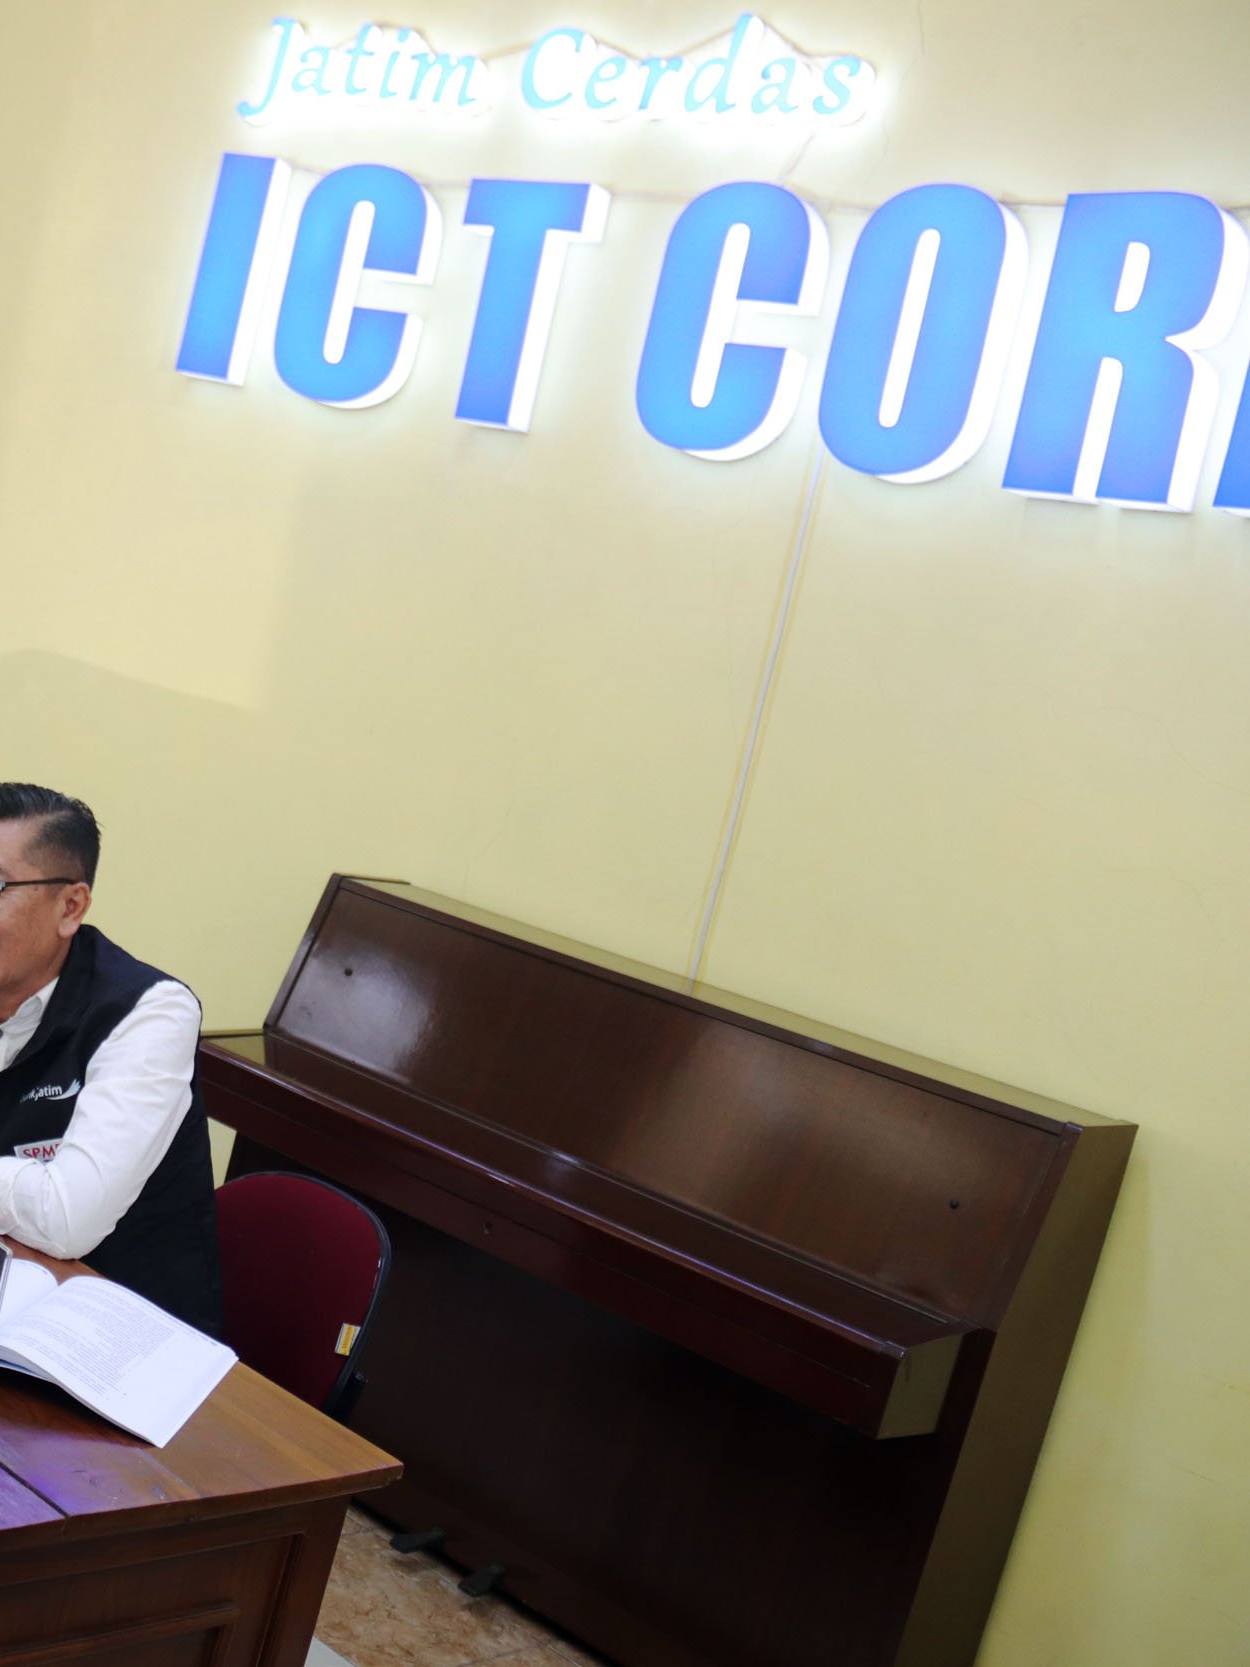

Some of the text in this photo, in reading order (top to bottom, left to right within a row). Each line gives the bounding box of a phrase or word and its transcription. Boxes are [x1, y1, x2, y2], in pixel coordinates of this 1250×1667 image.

[236, 14, 862, 118] Jatim Cerdas
[175, 152, 1250, 511] ICT COR
